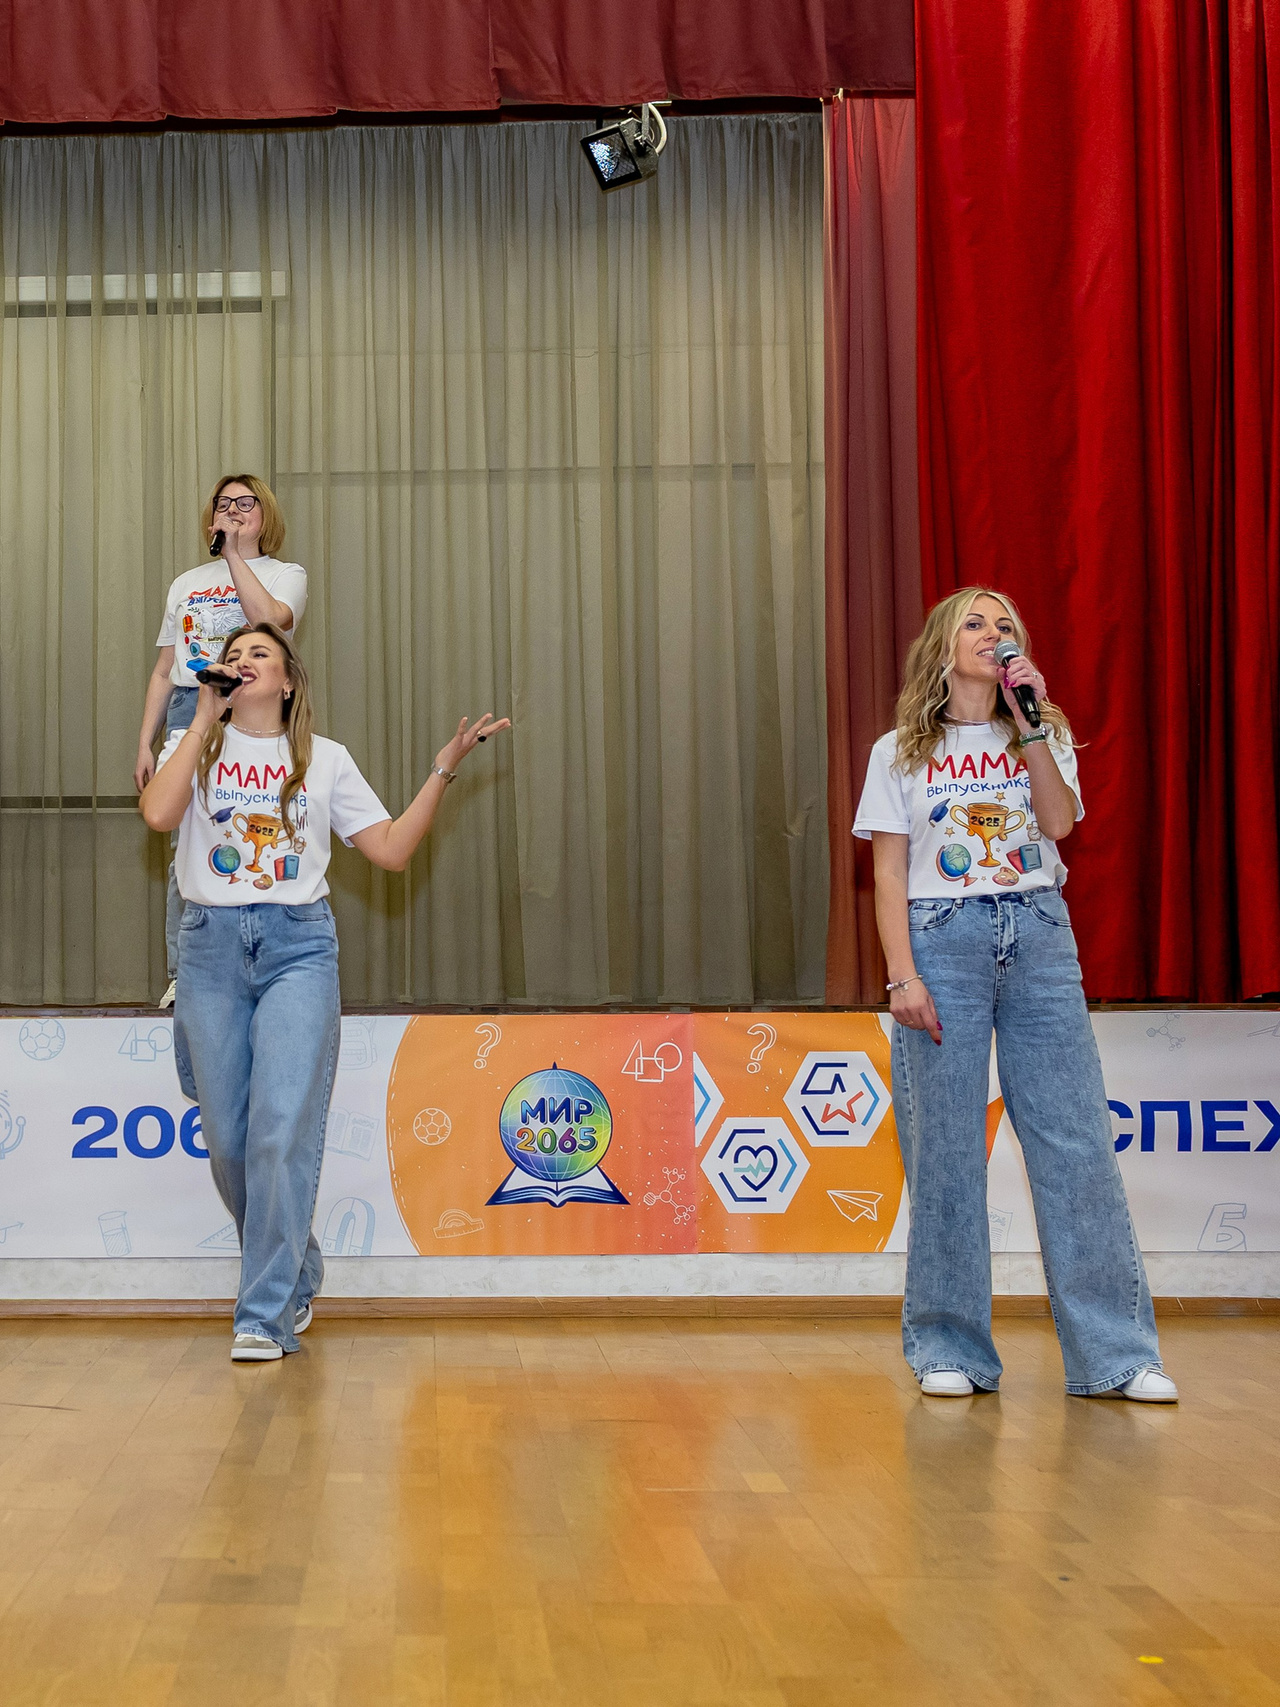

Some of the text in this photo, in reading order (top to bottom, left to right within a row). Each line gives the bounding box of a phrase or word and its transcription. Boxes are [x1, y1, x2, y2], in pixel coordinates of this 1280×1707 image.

[249, 824, 274, 836] 2025
[970, 815, 1000, 827] 2025
[520, 1097, 595, 1125] МИР
[71, 1105, 210, 1159] 206
[516, 1127, 598, 1154] 2065
